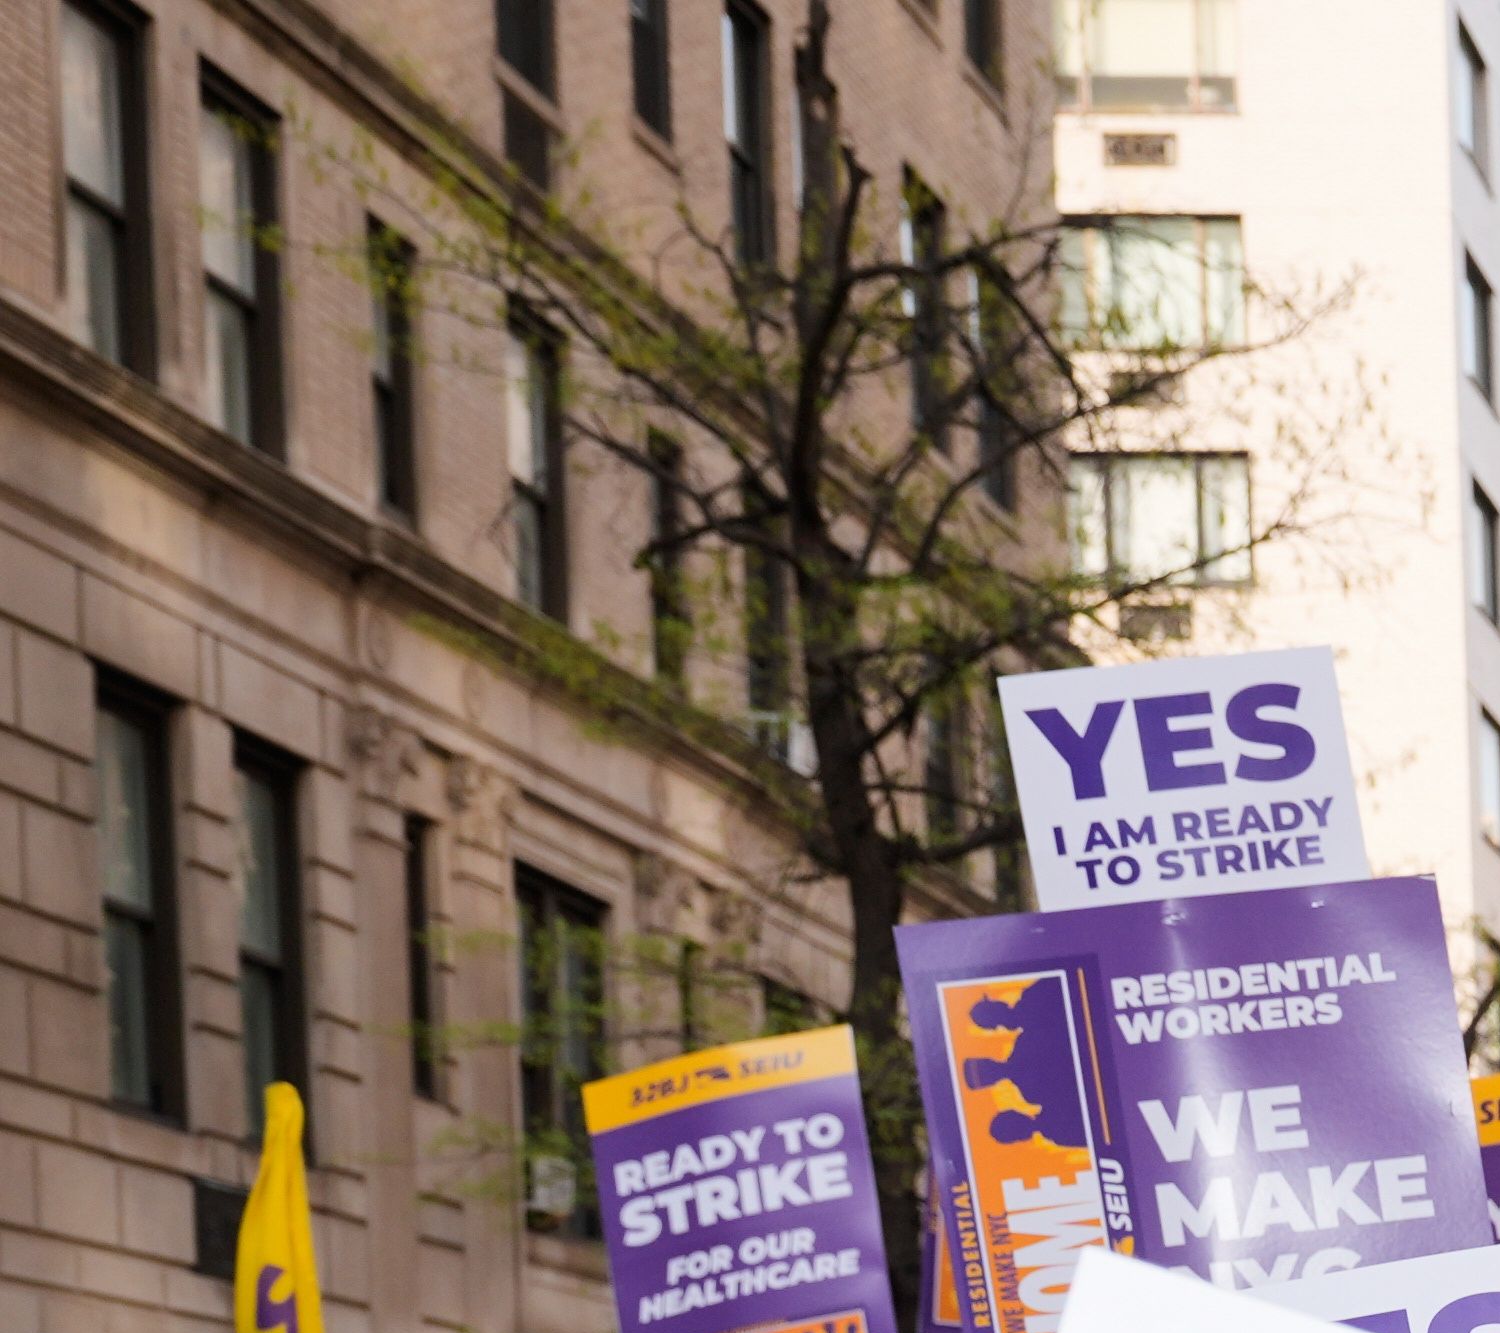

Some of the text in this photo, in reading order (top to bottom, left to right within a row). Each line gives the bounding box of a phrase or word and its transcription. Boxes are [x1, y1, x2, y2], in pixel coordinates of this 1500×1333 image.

[1024, 682, 1316, 800] YES
[1052, 796, 1334, 855] I AM READY
[1076, 835, 1325, 889] TO STRIKE
[1110, 952, 1396, 1009] RESIDENTIAL
[1114, 994, 1342, 1045] WORKERS
[614, 1113, 845, 1196] READY TO
[1138, 1084, 1310, 1162] WE
[620, 1152, 853, 1247] STRIKE
[1099, 1157, 1134, 1232] SEIU
[1154, 1155, 1436, 1248] MAKE
[639, 1249, 861, 1323] HEALTHCARE
[666, 1227, 816, 1286] FOR OUR
[952, 1180, 992, 1328] RESIDENTIAL
